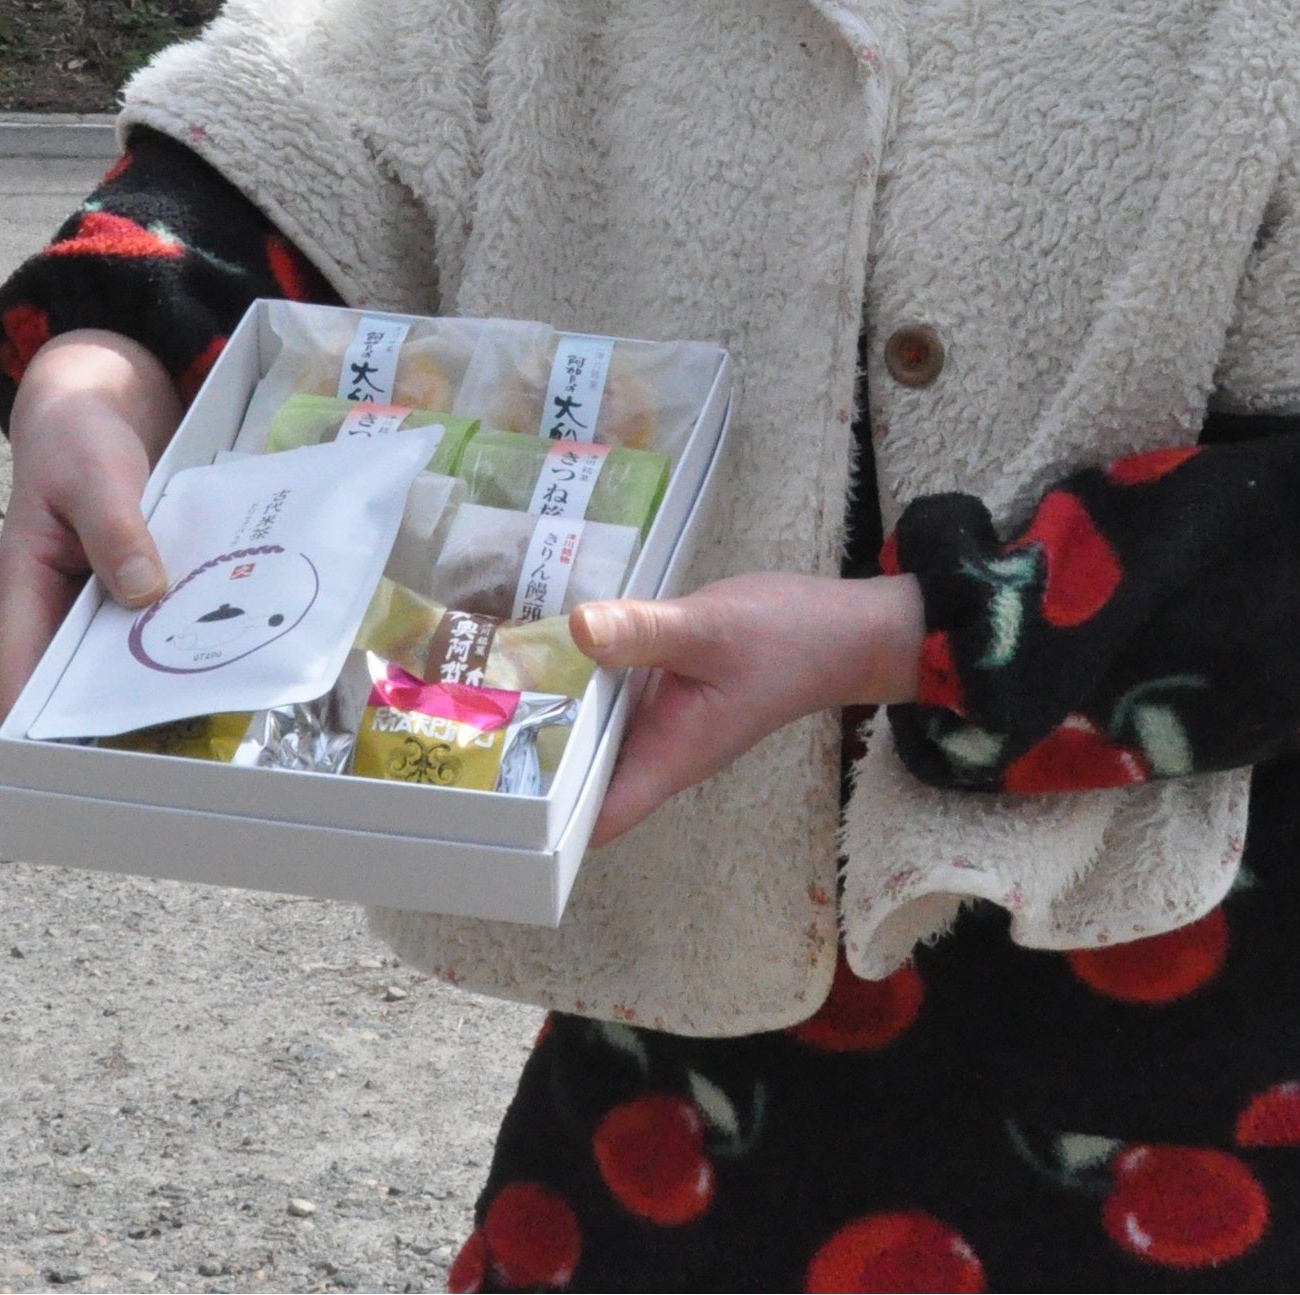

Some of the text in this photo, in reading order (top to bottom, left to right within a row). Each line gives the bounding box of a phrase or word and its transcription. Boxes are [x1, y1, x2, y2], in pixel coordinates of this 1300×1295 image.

[519, 532, 558, 624] きりん饅頭
